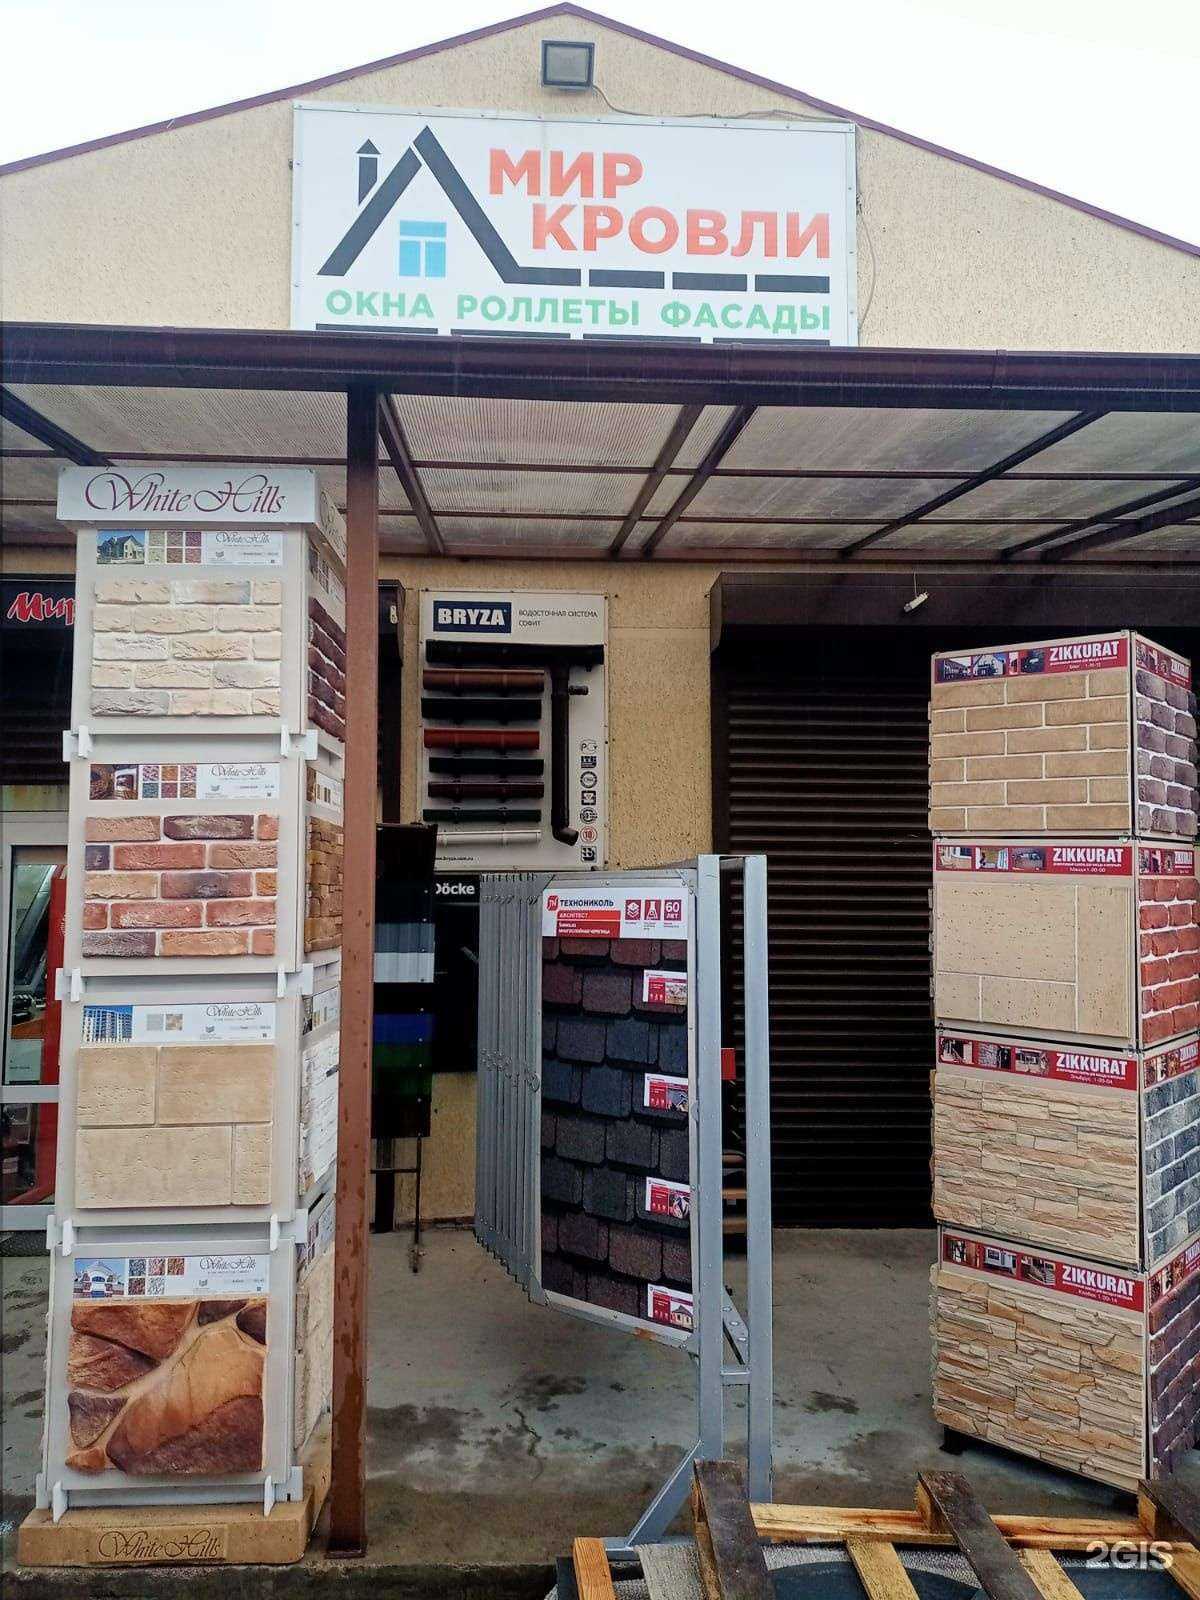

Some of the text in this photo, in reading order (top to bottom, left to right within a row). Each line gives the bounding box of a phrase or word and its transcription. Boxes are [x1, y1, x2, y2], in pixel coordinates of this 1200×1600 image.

[489, 147, 644, 199] МИР
[531, 202, 831, 259] КРОВЛИ
[325, 288, 831, 334] ОКНА РОЛЛЕТЫ ФАСАДЫ
[84, 472, 286, 514] White Hills
[437, 607, 506, 626] BRYZA
[518, 619, 541, 628] СОФИТ
[568, 610, 598, 619] СИСТЕМА
[1049, 641, 1120, 662] ZIKKURAT
[1052, 847, 1124, 863] ZIKKURAT
[559, 899, 615, 908] ТЕХНОНИКОЛЬ
[665, 901, 680, 913] 60
[1056, 1053, 1128, 1076] ZIKKURAT
[1062, 1265, 1135, 1297] ZIKKURAT
[98, 1528, 222, 1559] White Hills
